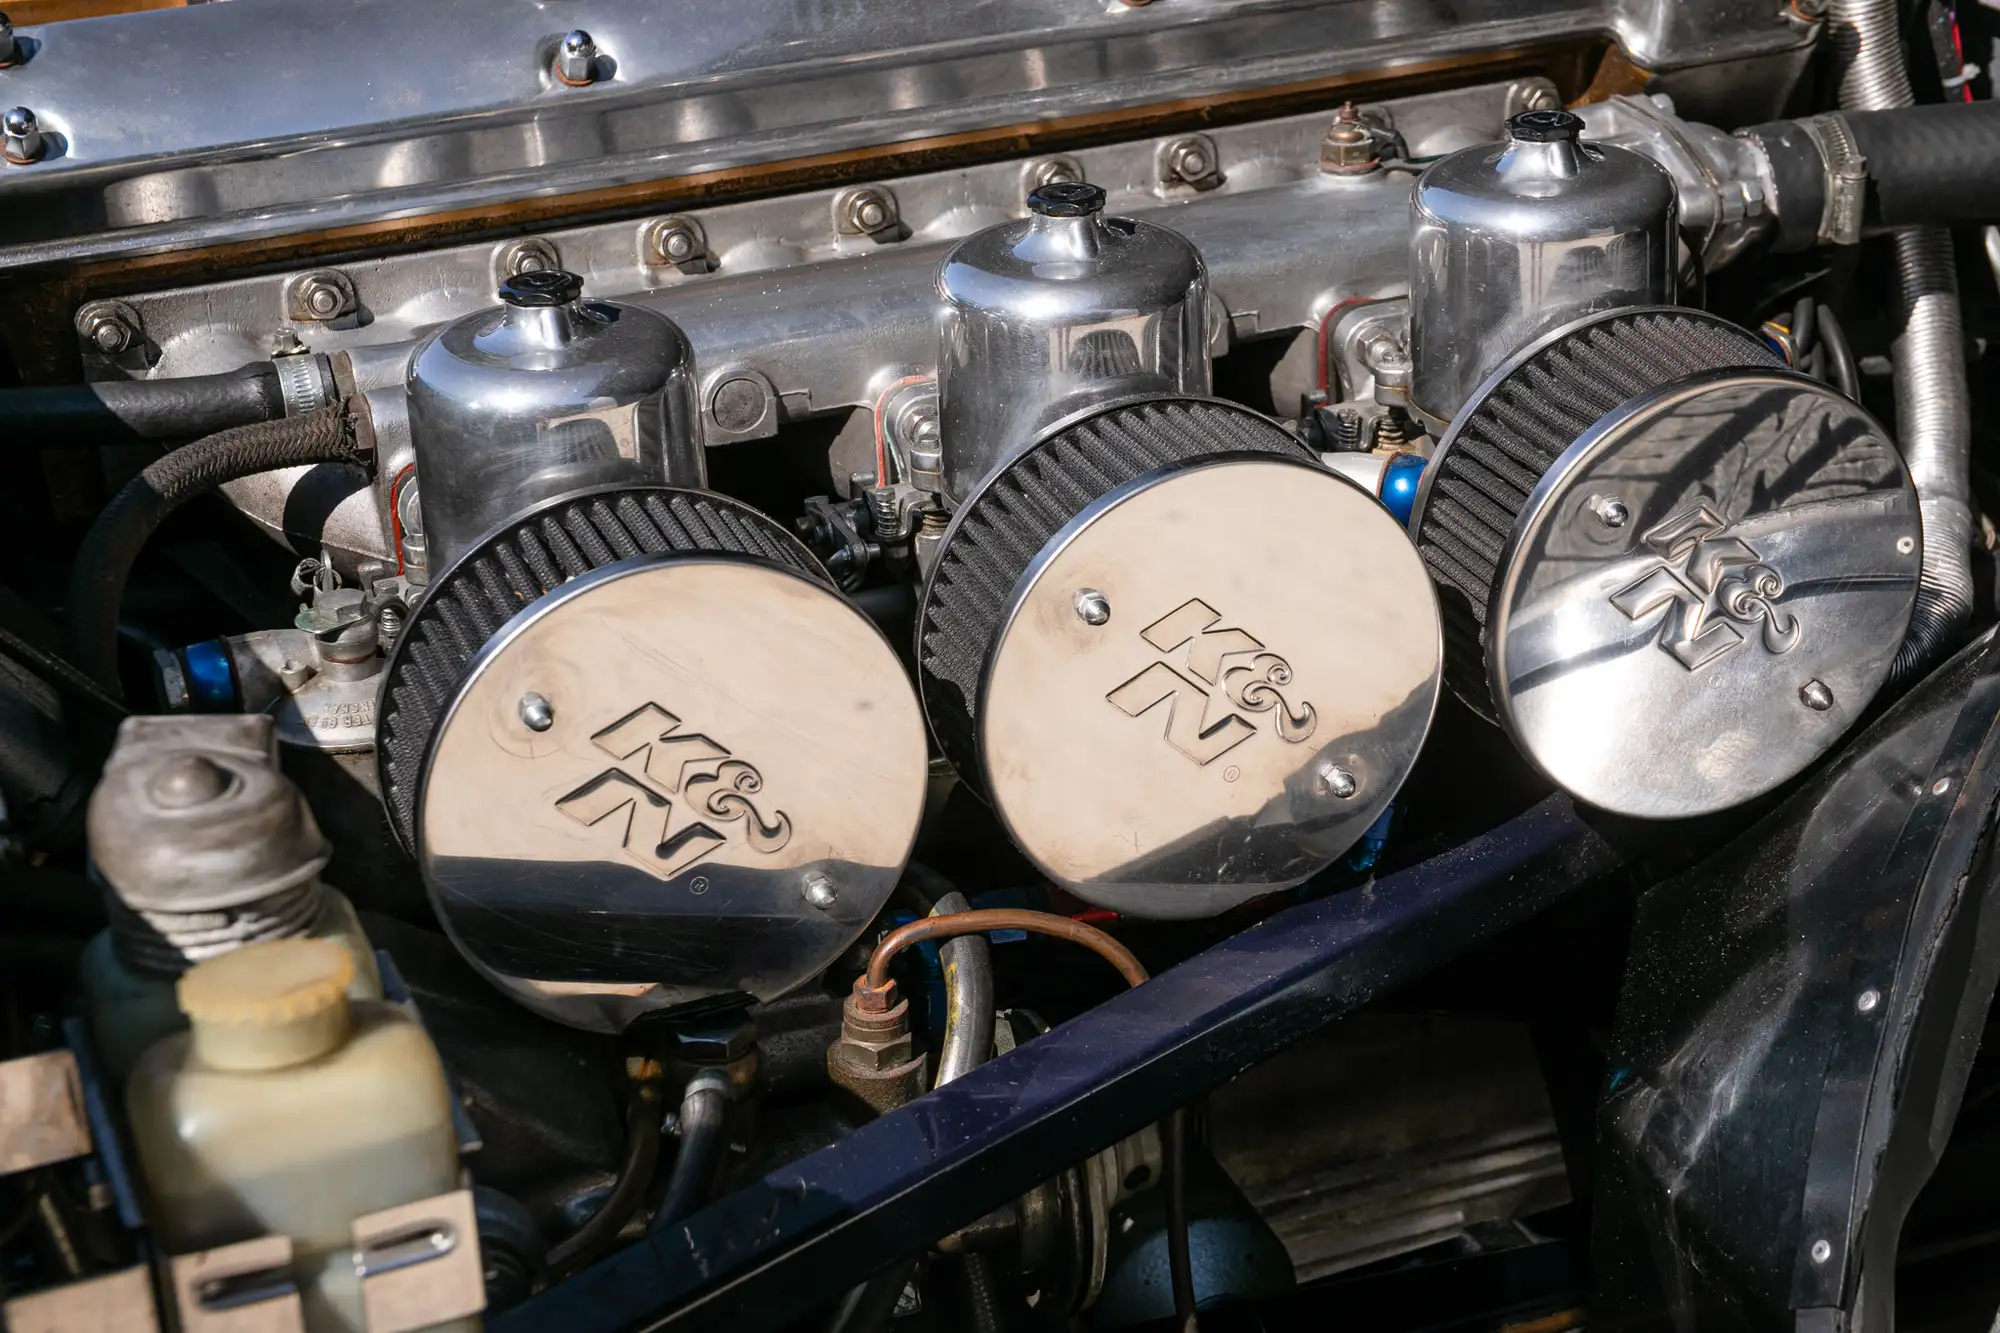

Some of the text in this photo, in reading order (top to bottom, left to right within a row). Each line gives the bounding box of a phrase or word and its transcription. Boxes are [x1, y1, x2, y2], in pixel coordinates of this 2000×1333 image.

[1610, 503, 1801, 673] K&N
[1105, 597, 1318, 766] K&N
[554, 700, 792, 877] K&N
